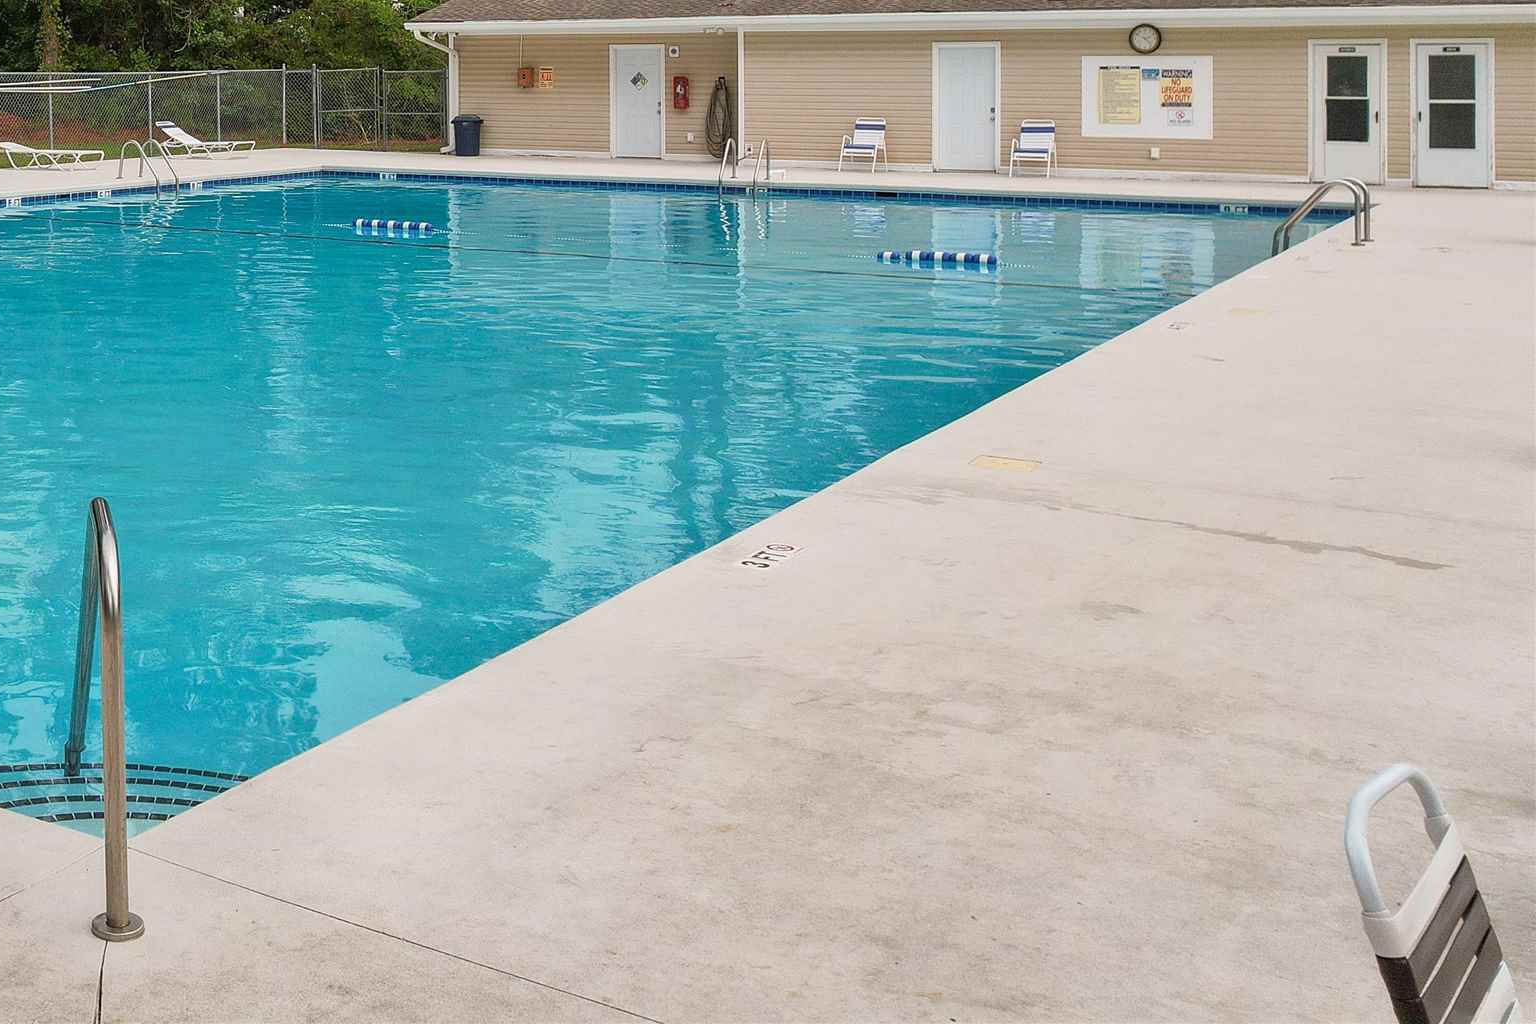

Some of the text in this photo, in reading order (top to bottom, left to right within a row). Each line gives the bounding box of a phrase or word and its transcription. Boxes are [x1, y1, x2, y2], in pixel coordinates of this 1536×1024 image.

[1170, 78, 1182, 86] NO
[1161, 86, 1192, 94] LIFEGUARD
[1164, 94, 1191, 102] ON DUTY
